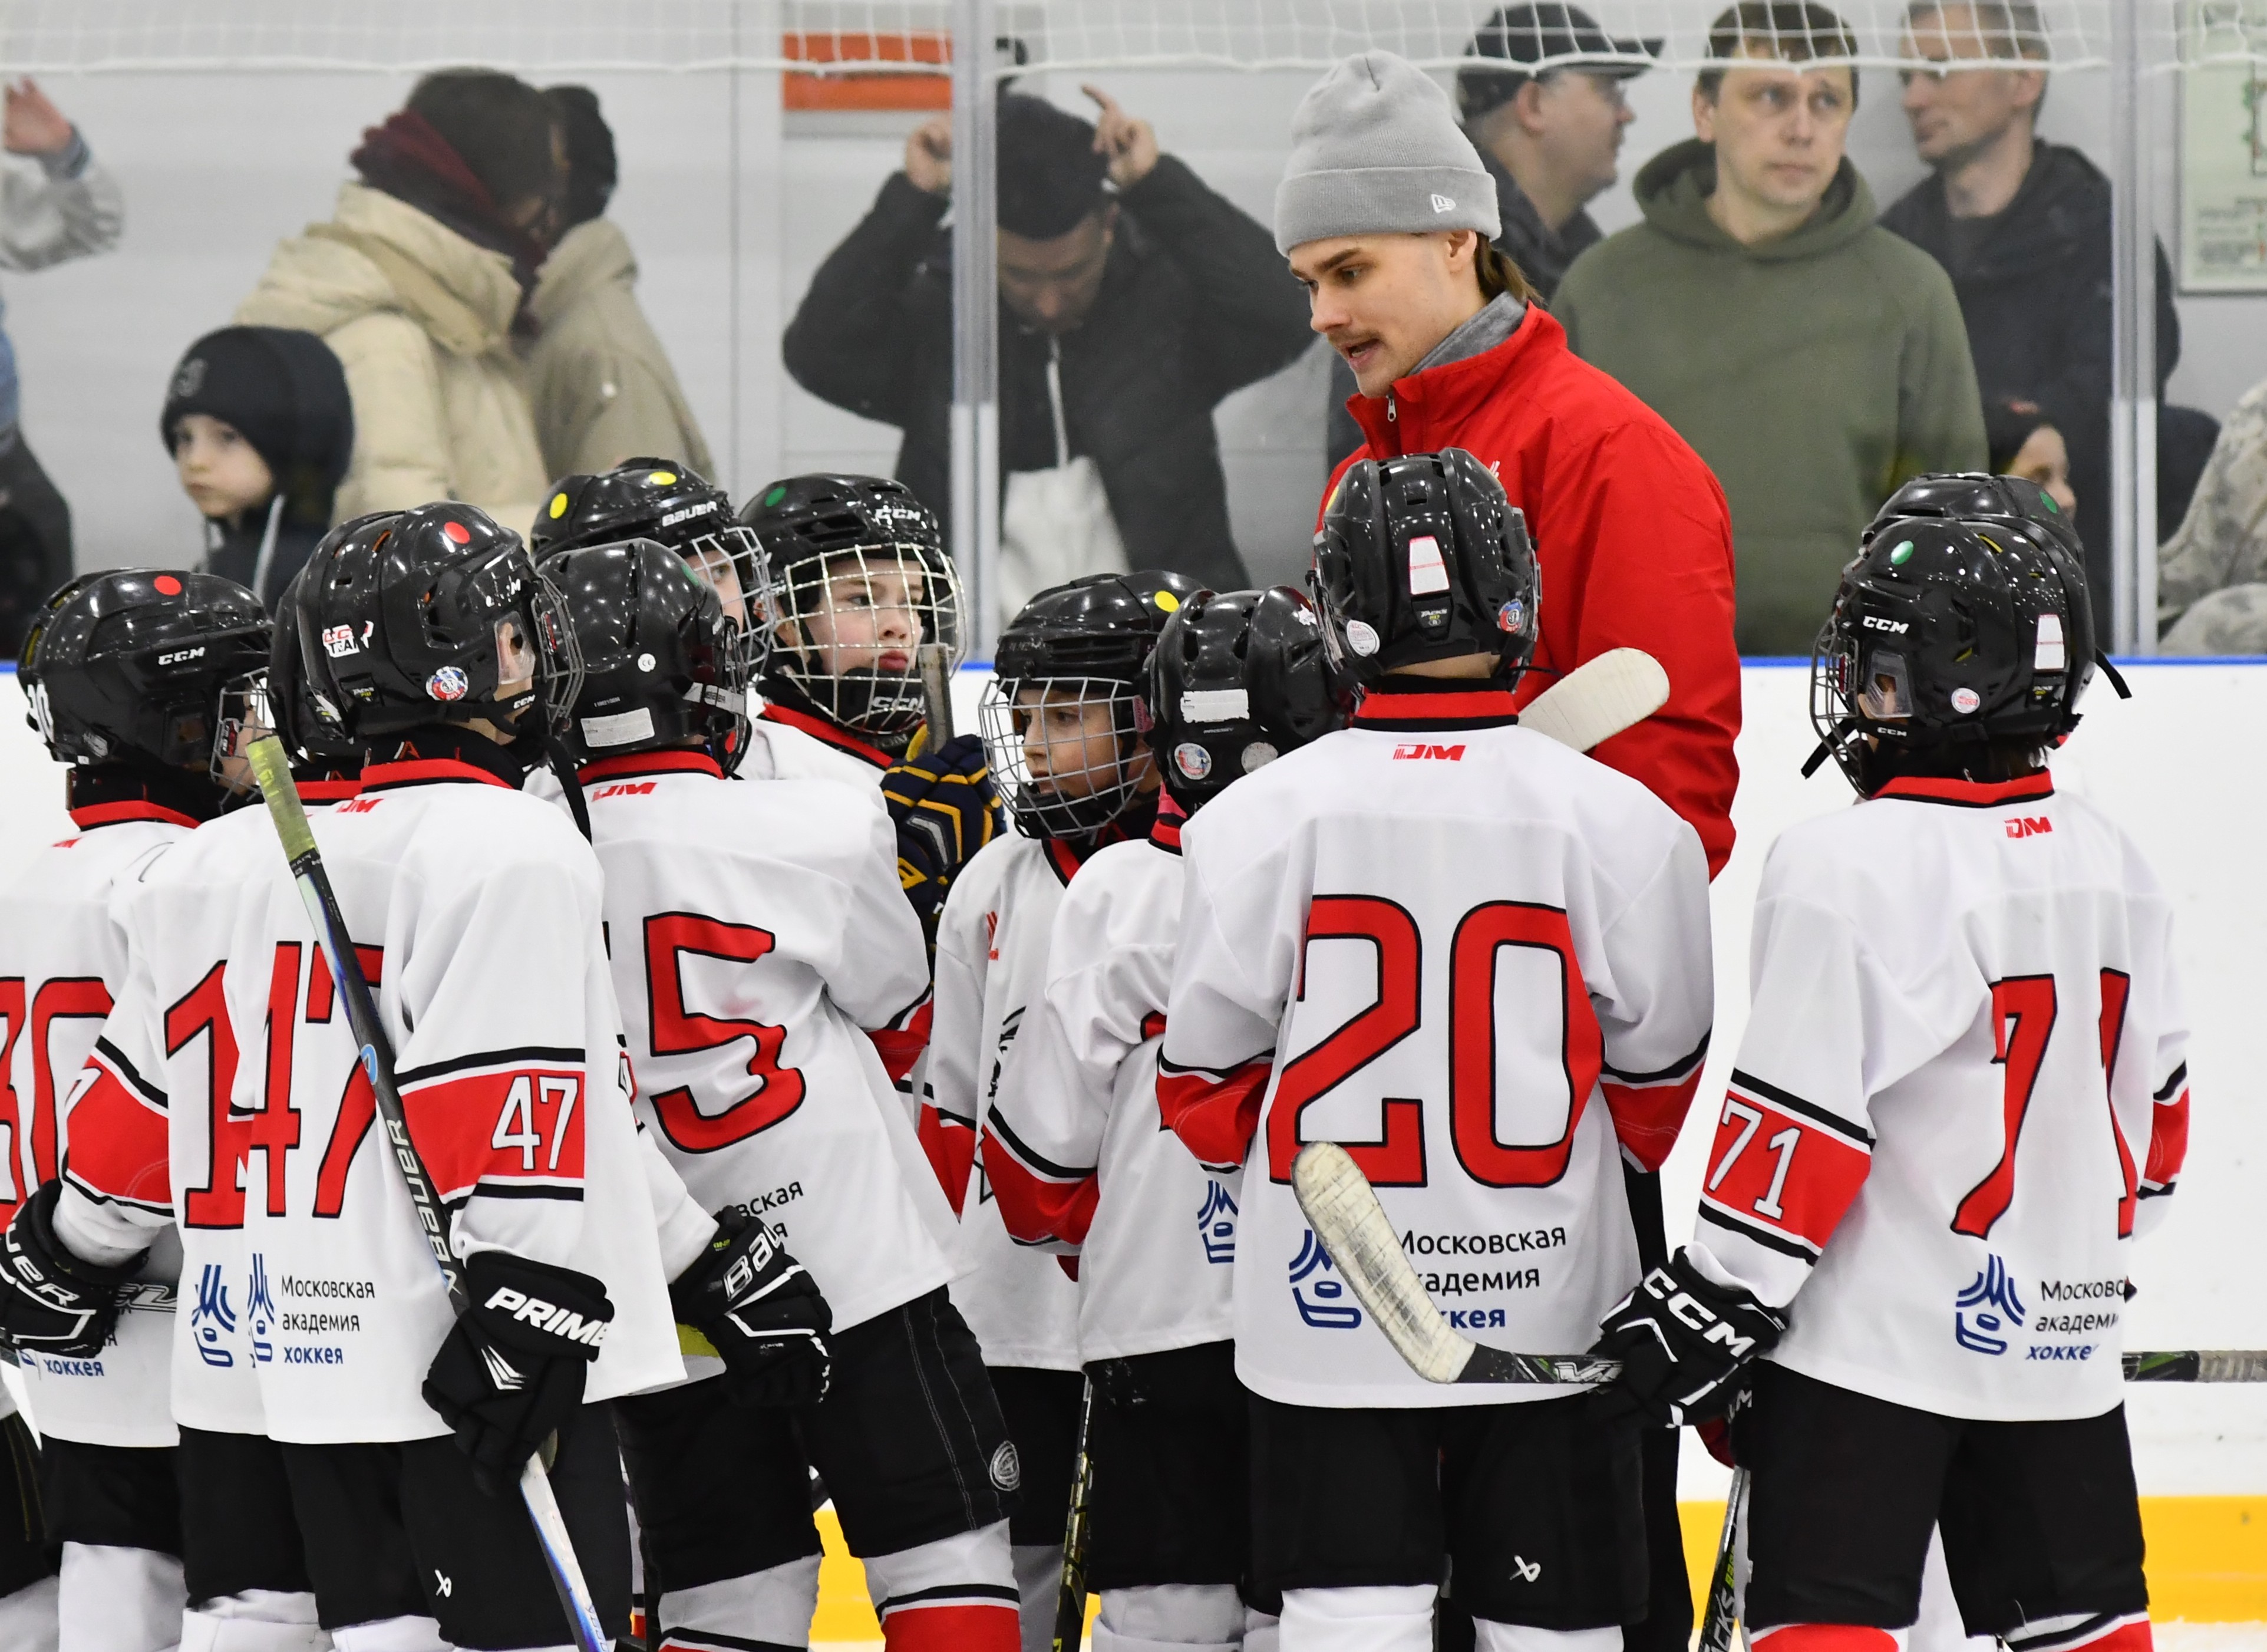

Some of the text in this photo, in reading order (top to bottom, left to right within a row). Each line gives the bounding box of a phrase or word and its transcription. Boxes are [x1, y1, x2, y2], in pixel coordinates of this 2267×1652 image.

[875, 508, 921, 521] CCM
[1863, 616, 1909, 634] CCM
[158, 647, 206, 665] CCM
[513, 694, 536, 709] CCM
[1877, 726, 1908, 737] CCM
[1267, 893, 1606, 1189] 20
[249, 939, 385, 1218] 47
[491, 1074, 579, 1170] 47
[1705, 1096, 1800, 1220] 71
[281, 1275, 375, 1299] Московская
[1417, 1268, 1540, 1297] адемия
[2041, 1280, 2125, 1302] Московс
[1440, 1308, 1506, 1330] кея
[1642, 1267, 1757, 1358] CCM
[282, 1313, 361, 1336] академия
[283, 1346, 344, 1365] хоккея
[2024, 1344, 2100, 1361] хокке
[43, 1358, 105, 1377] хоккея
